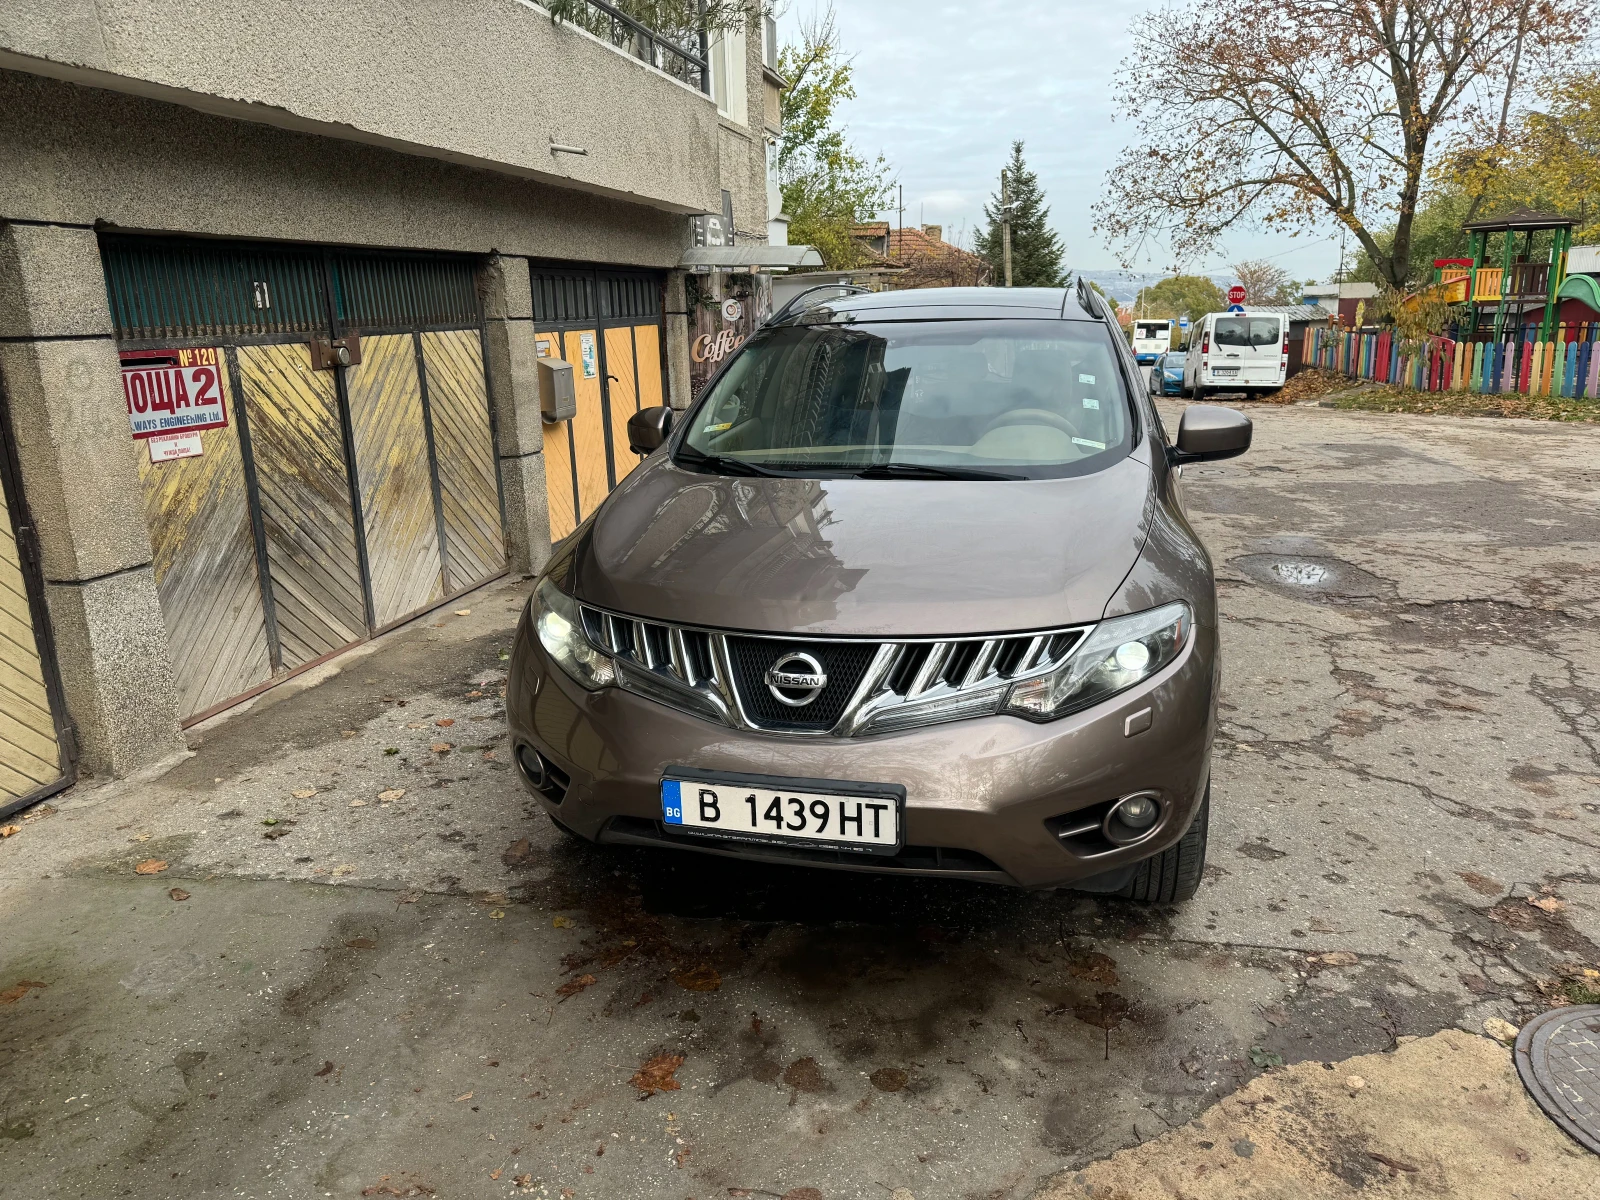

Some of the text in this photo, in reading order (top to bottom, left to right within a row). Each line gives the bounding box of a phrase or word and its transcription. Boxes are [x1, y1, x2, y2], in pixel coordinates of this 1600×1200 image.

[1229, 291, 1245, 299] STOP
[691, 328, 745, 363] Coffee
[194, 348, 216, 366] 120
[191, 368, 218, 406] 2
[132, 419, 158, 431] WAYS
[770, 675, 820, 686] NISSAN
[666, 807, 681, 818] BG
[698, 788, 721, 823] B
[744, 793, 830, 834] 1439
